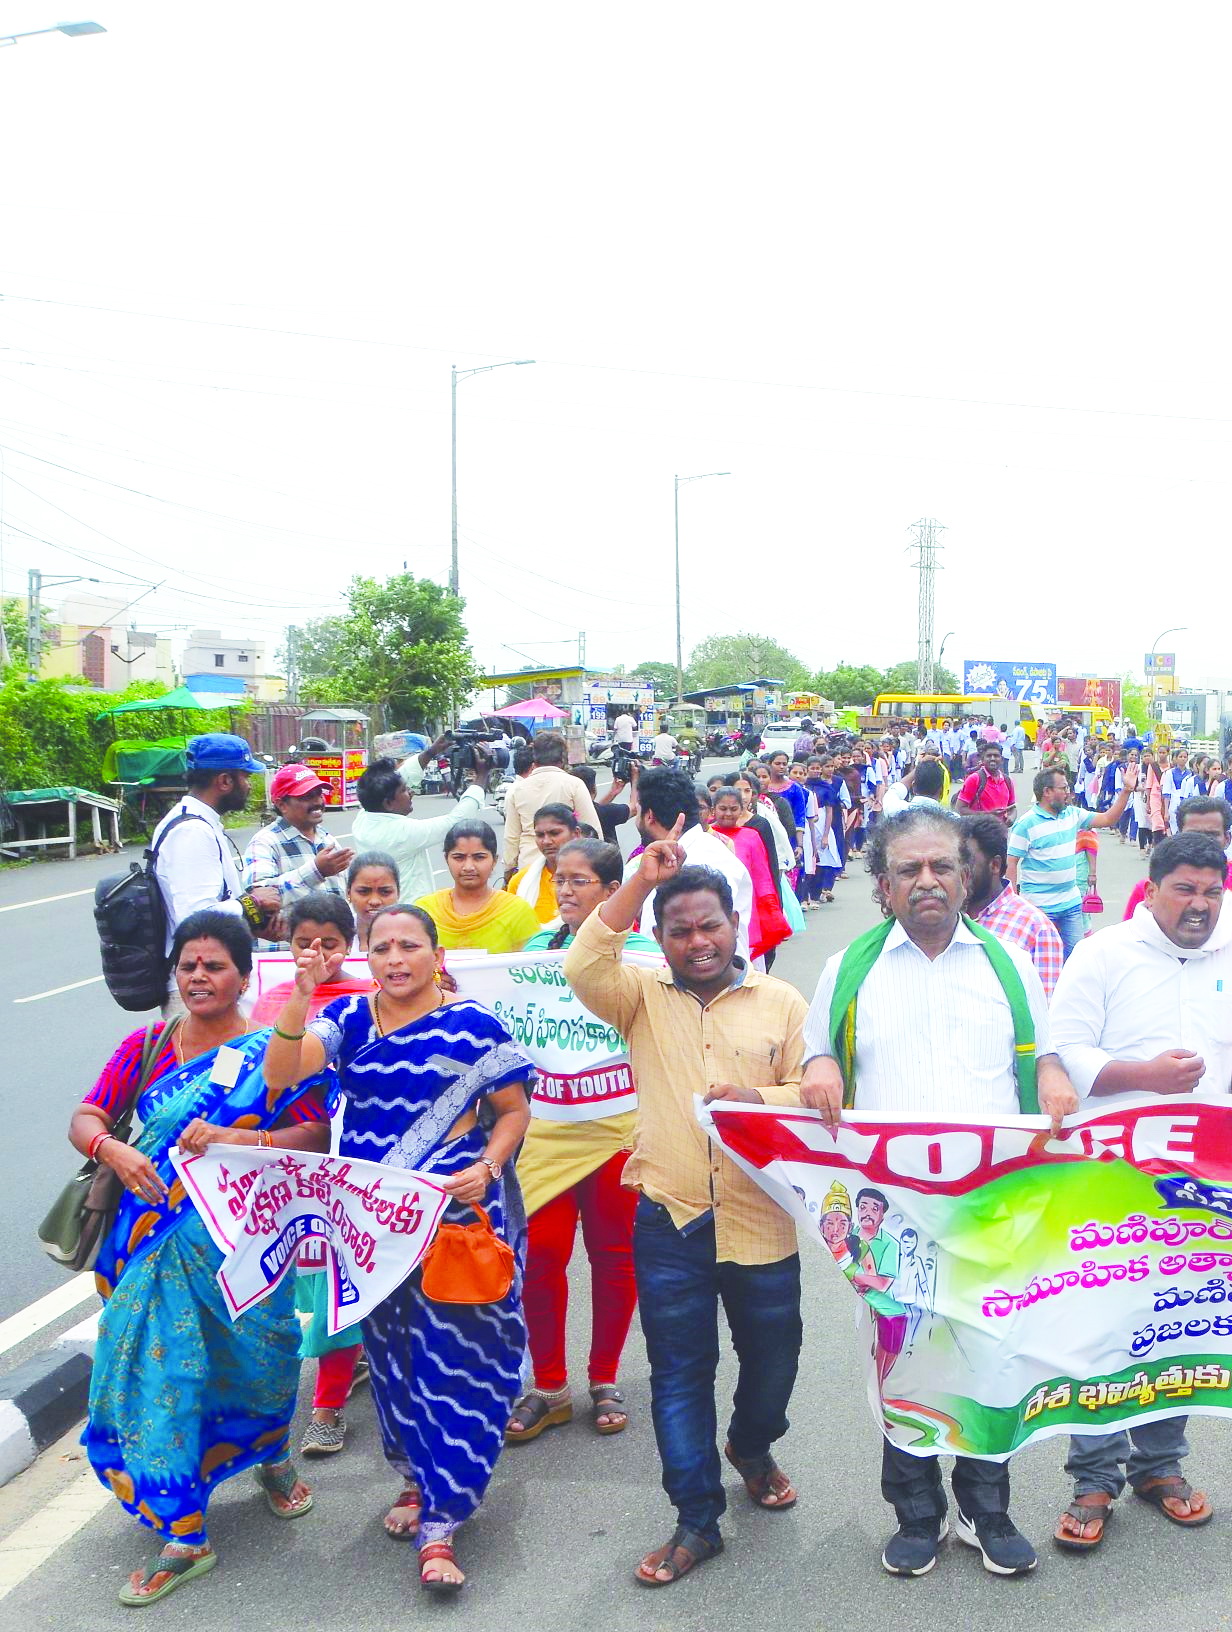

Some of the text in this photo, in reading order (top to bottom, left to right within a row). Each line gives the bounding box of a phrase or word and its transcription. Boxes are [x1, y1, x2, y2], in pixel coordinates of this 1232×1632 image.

[1016, 679, 1054, 703] 75%
[591, 711, 606, 720] 199
[639, 713, 653, 721] 119
[639, 743, 652, 752] 69
[549, 1078, 569, 1098] OF
[567, 1067, 631, 1098] YOUTH
[263, 1219, 306, 1275] VOICE
[310, 1218, 334, 1239] OF
[981, 1254, 1150, 1318] సామూహిక
[1077, 1363, 1230, 1411] భవిష్యత్తుకు
